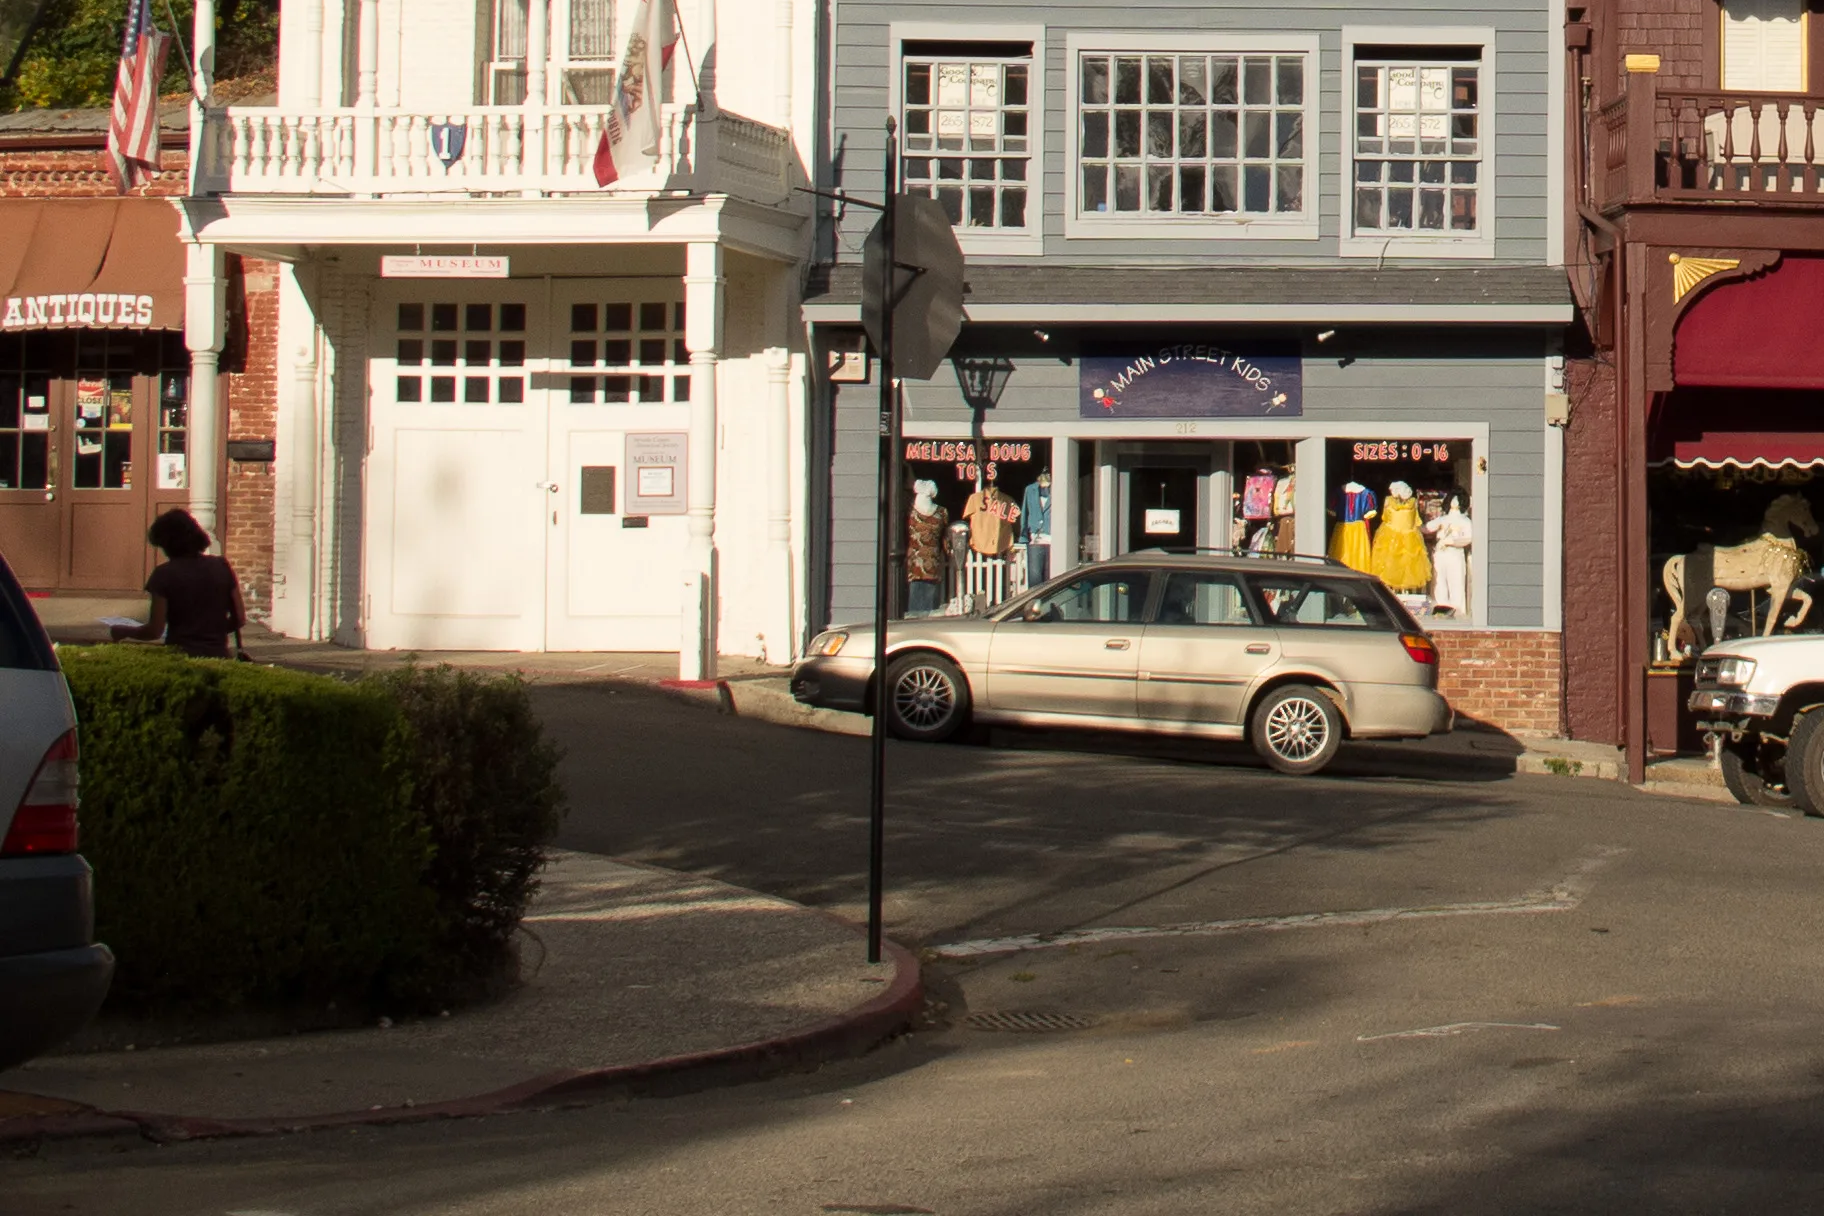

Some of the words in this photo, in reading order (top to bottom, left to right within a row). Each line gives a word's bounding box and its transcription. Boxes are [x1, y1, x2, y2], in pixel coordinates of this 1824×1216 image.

[439, 127, 451, 159] 1
[420, 260, 500, 268] MUSEUM
[2, 293, 154, 327] ANTIQUES
[1110, 356, 1156, 392] MAIN
[1158, 344, 1232, 365] STREET
[1231, 356, 1271, 391] KIDS
[1175, 423, 1197, 434] 212
[633, 455, 677, 464] MUSEUM
[905, 442, 976, 461] MELISSA
[989, 443, 1031, 461] DOUG
[956, 462, 997, 480] TOS
[979, 495, 1022, 524] SALE
